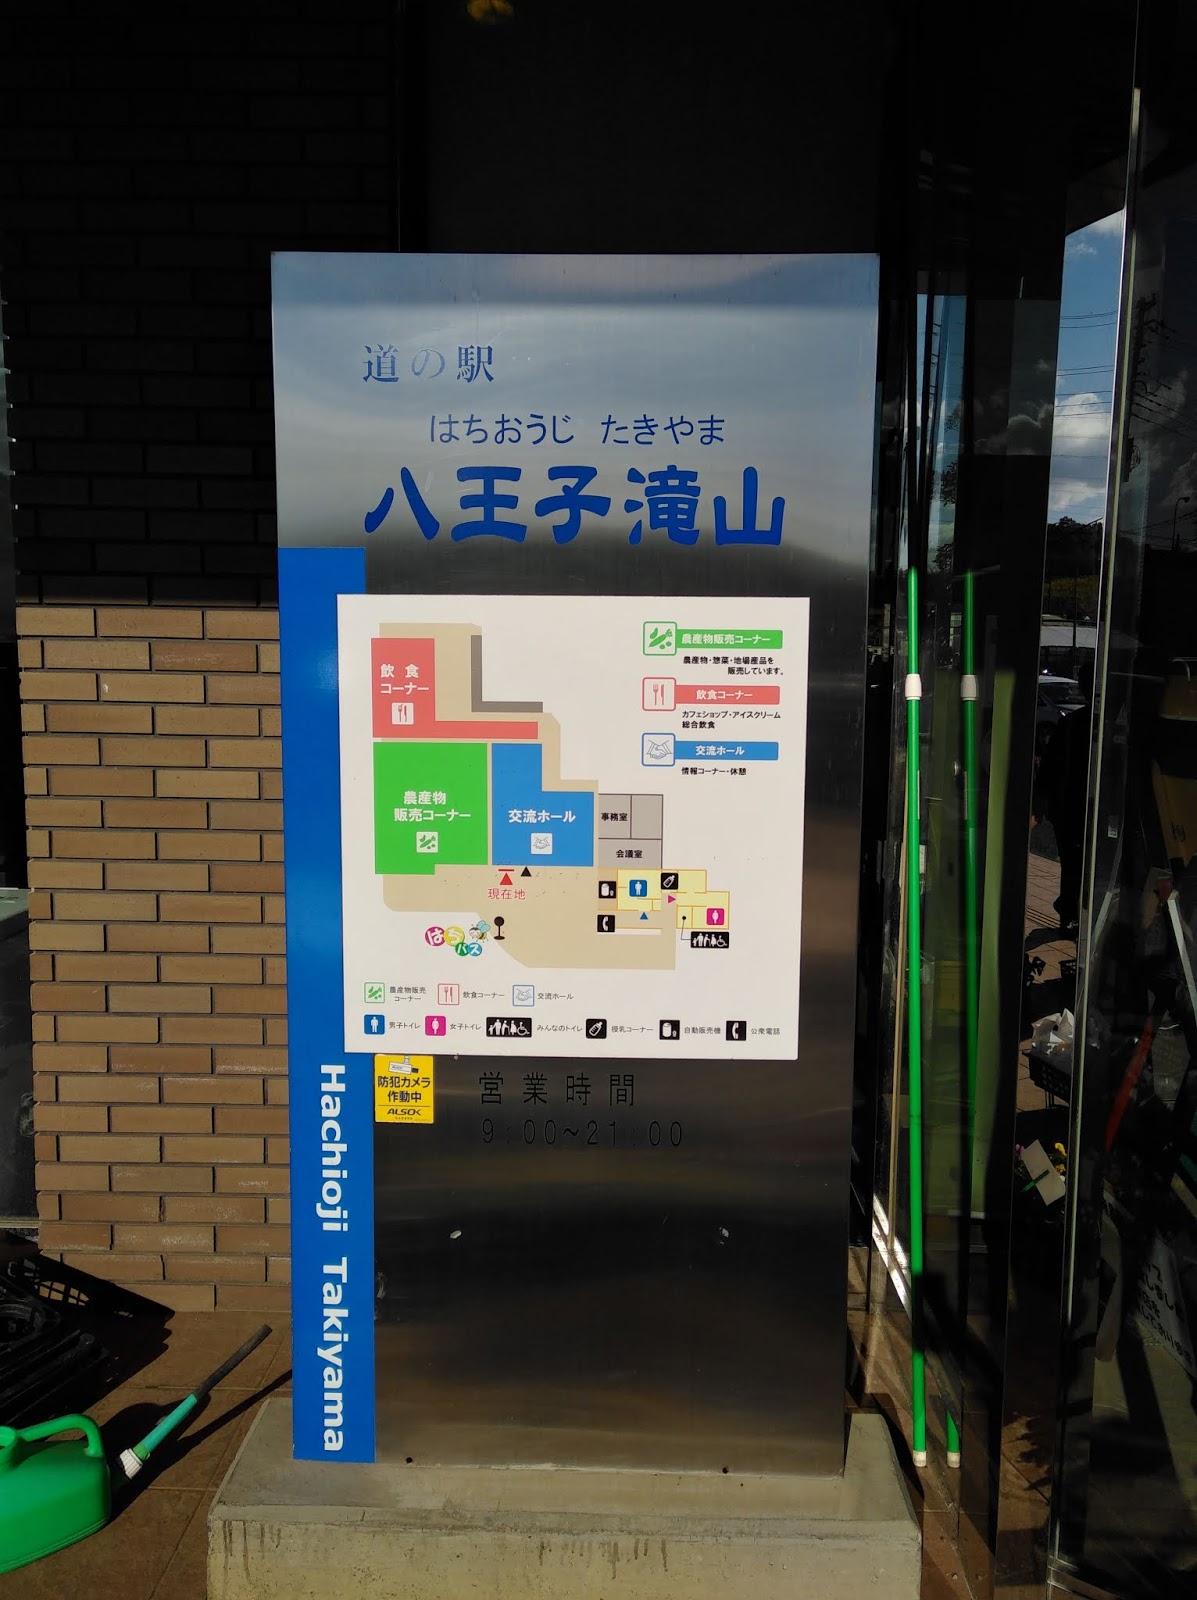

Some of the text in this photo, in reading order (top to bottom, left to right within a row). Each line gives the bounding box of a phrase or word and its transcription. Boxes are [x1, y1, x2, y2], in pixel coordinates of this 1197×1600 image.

[362, 344, 494, 384] 道の駅
[431, 414, 724, 446] はちおうじ たきやま
[365, 465, 785, 546] 八王子滝山
[681, 633, 771, 645] 農産物販売コーナー
[380, 681, 430, 695] コーナー
[695, 689, 753, 701] 飲食コーナー
[682, 710, 781, 719] カフェショップ・アイスクリーム
[681, 720, 715, 729] 総合飲食
[695, 744, 745, 756] 交流ホール
[681, 766, 747, 776] 情報コーナー・休憩
[403, 791, 447, 805] 農産物
[393, 807, 471, 822] 販売コーナー
[508, 808, 576, 824] 交流ホール
[600, 812, 628, 822] 事務室
[615, 849, 643, 859] 会議室
[487, 888, 526, 900] 現在地
[456, 943, 483, 956] バス
[389, 986, 427, 995] 農産物販売
[462, 991, 505, 999] 飲食コーナー
[394, 995, 422, 1003] コーナー
[537, 992, 574, 1001] 交流ホール
[389, 1021, 421, 1030] 男子トイレ
[449, 1023, 482, 1031] 女子トイレ
[536, 1024, 583, 1032] みんなのトイレ
[611, 1025, 654, 1033] 授乳コーナー
[684, 1026, 721, 1035] 自動販売機
[750, 1027, 781, 1036] 公衆電話
[377, 1075, 431, 1089] 防犯カメラ
[478, 1072, 633, 1106] 営業時間
[388, 1091, 422, 1103] 作動中
[387, 1108, 421, 1116] ALSOK
[316, 1065, 348, 1450] Hachioji Takiyama
